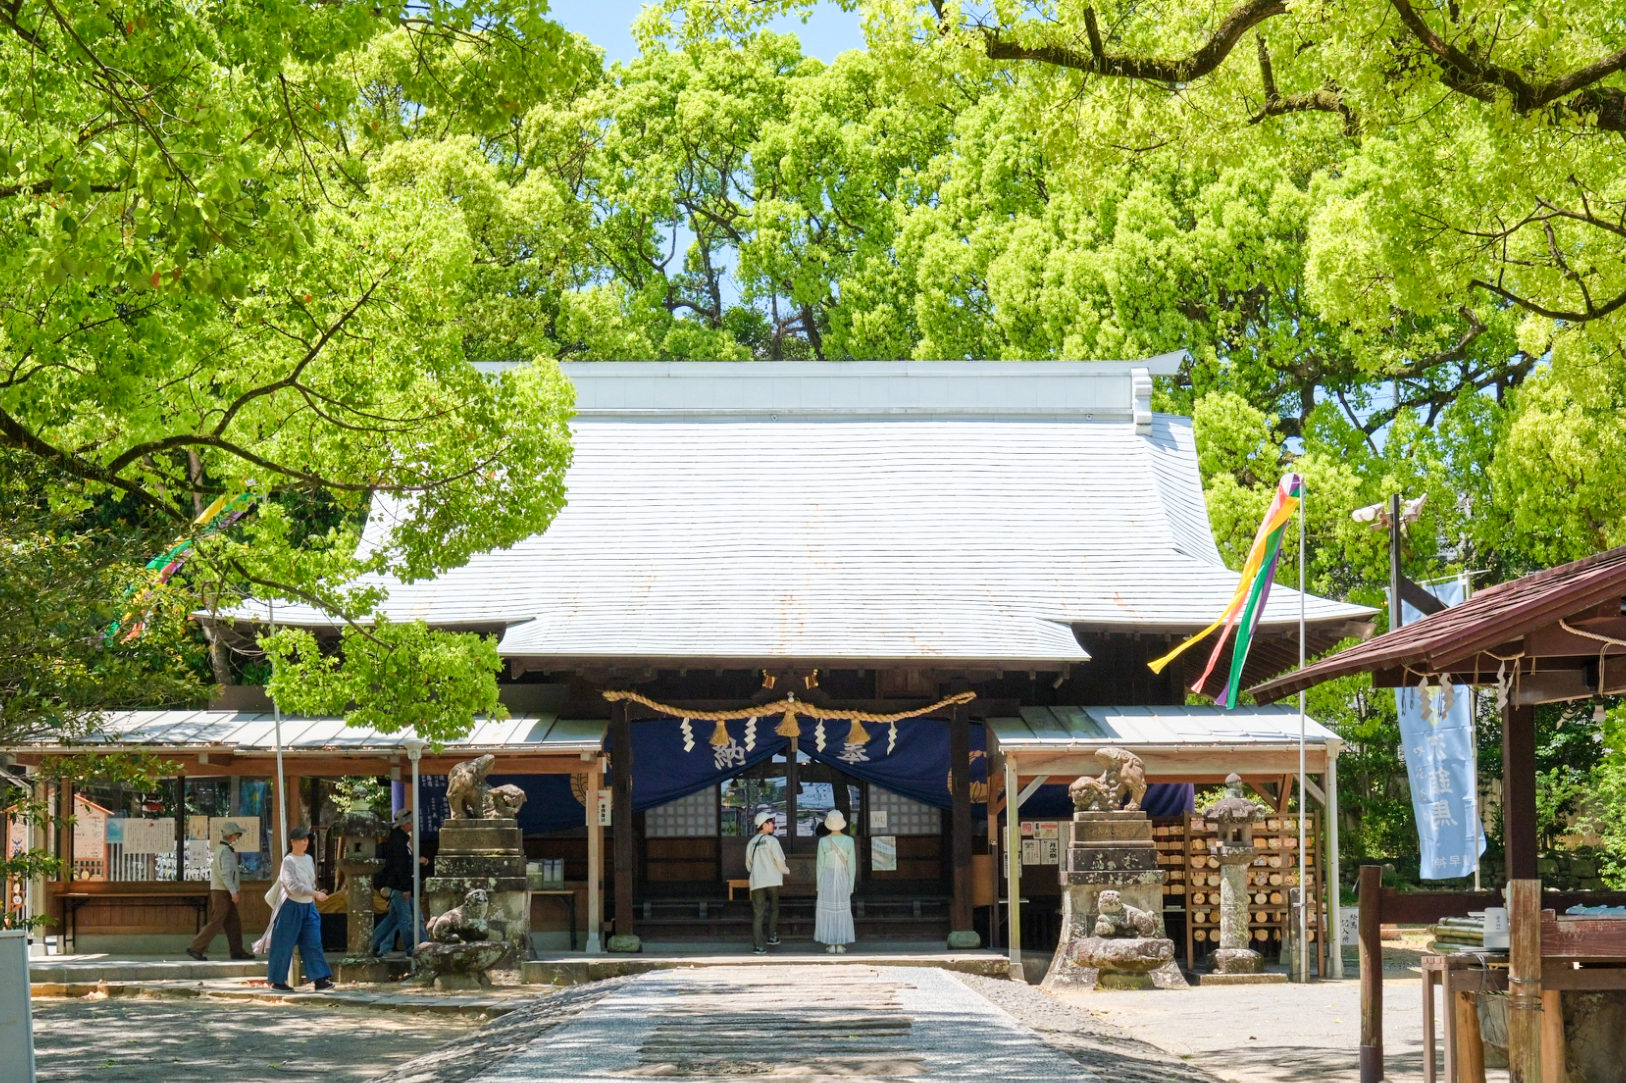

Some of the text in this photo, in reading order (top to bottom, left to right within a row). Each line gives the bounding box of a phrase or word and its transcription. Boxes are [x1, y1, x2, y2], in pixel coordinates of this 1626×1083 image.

[711, 736, 870, 770] 奉 納
[1341, 919, 1350, 944] 記入所
[1350, 913, 1359, 930] 絵馬
